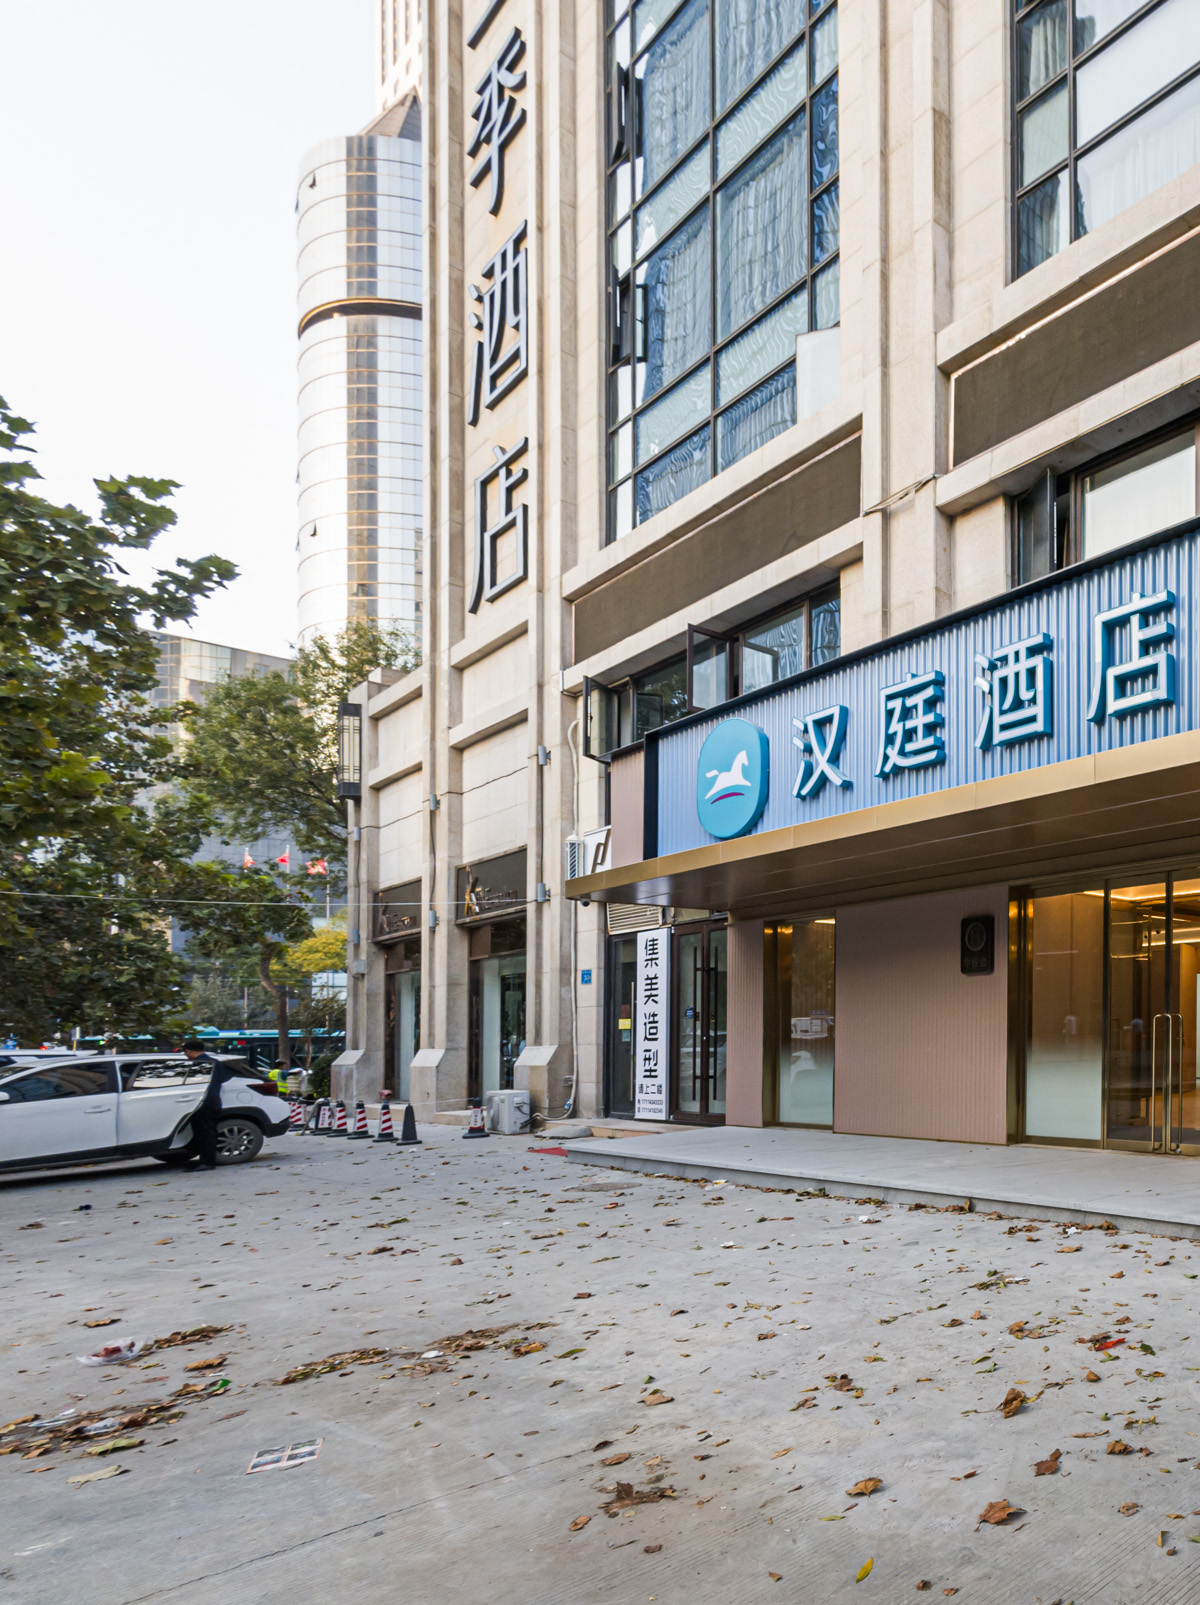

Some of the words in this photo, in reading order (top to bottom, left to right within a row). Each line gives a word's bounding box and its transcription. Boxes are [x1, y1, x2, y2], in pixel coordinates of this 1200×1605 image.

[467, 0, 528, 614] 季酒店
[792, 589, 1176, 800] 汉庭酒店
[643, 937, 659, 1079] 集美造型
